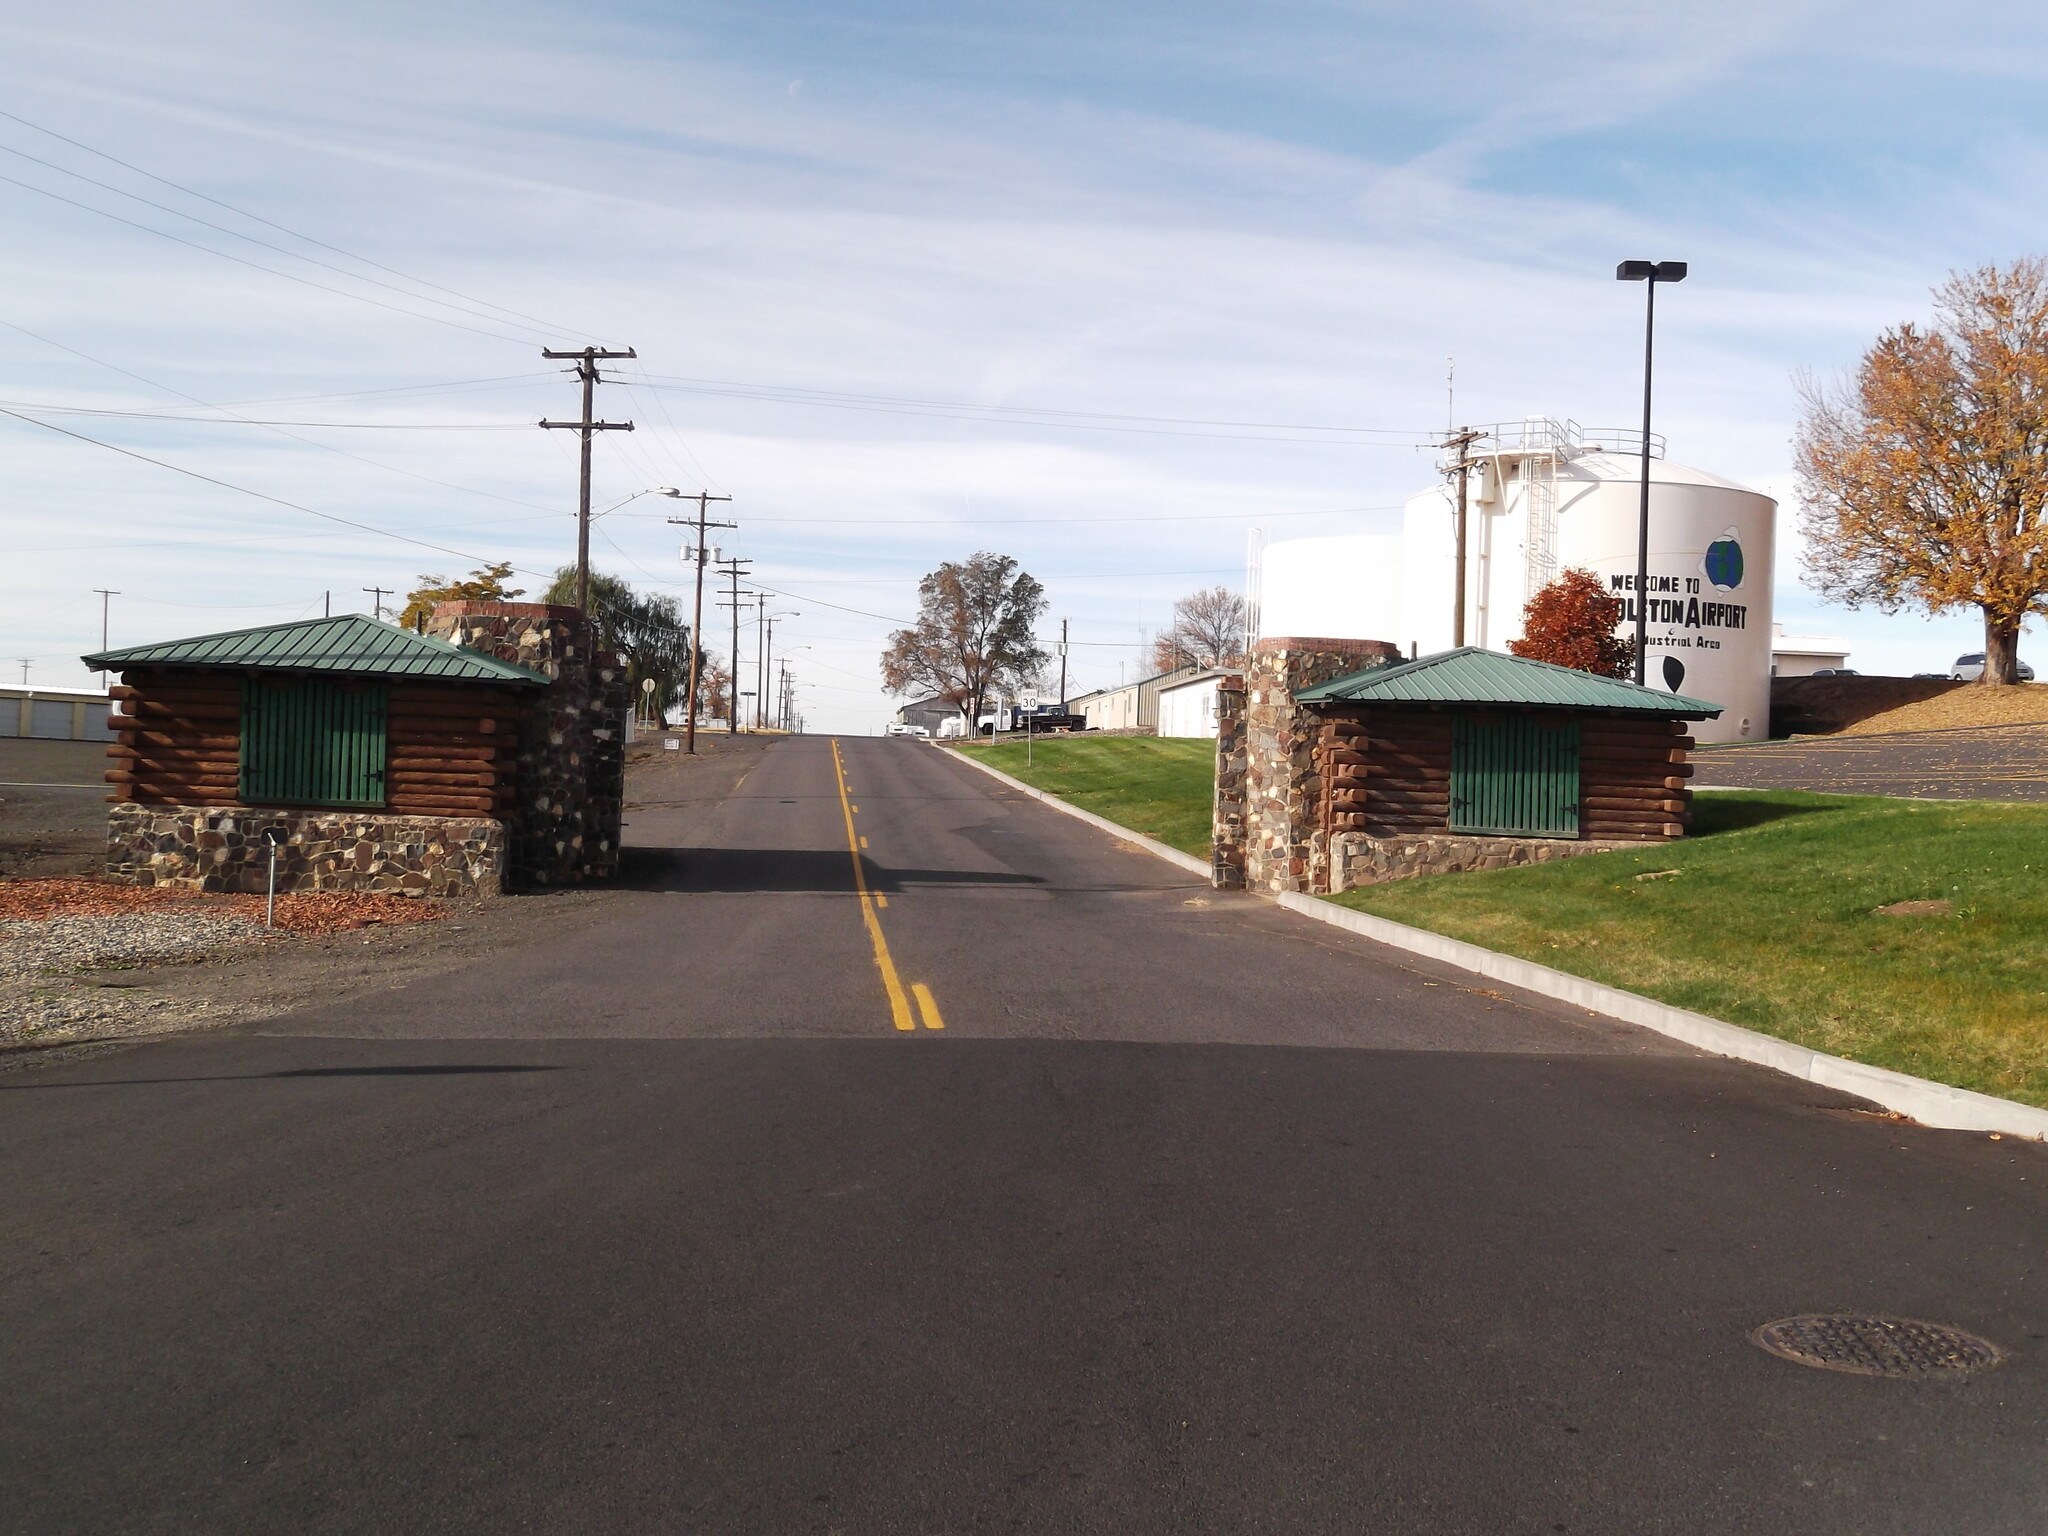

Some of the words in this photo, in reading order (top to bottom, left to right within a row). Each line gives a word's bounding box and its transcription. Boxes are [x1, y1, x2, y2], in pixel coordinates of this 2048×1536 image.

[1685, 578, 1700, 594] TO
[1685, 597, 1747, 629] AIRPORT
[1022, 698, 1036, 708] 30
